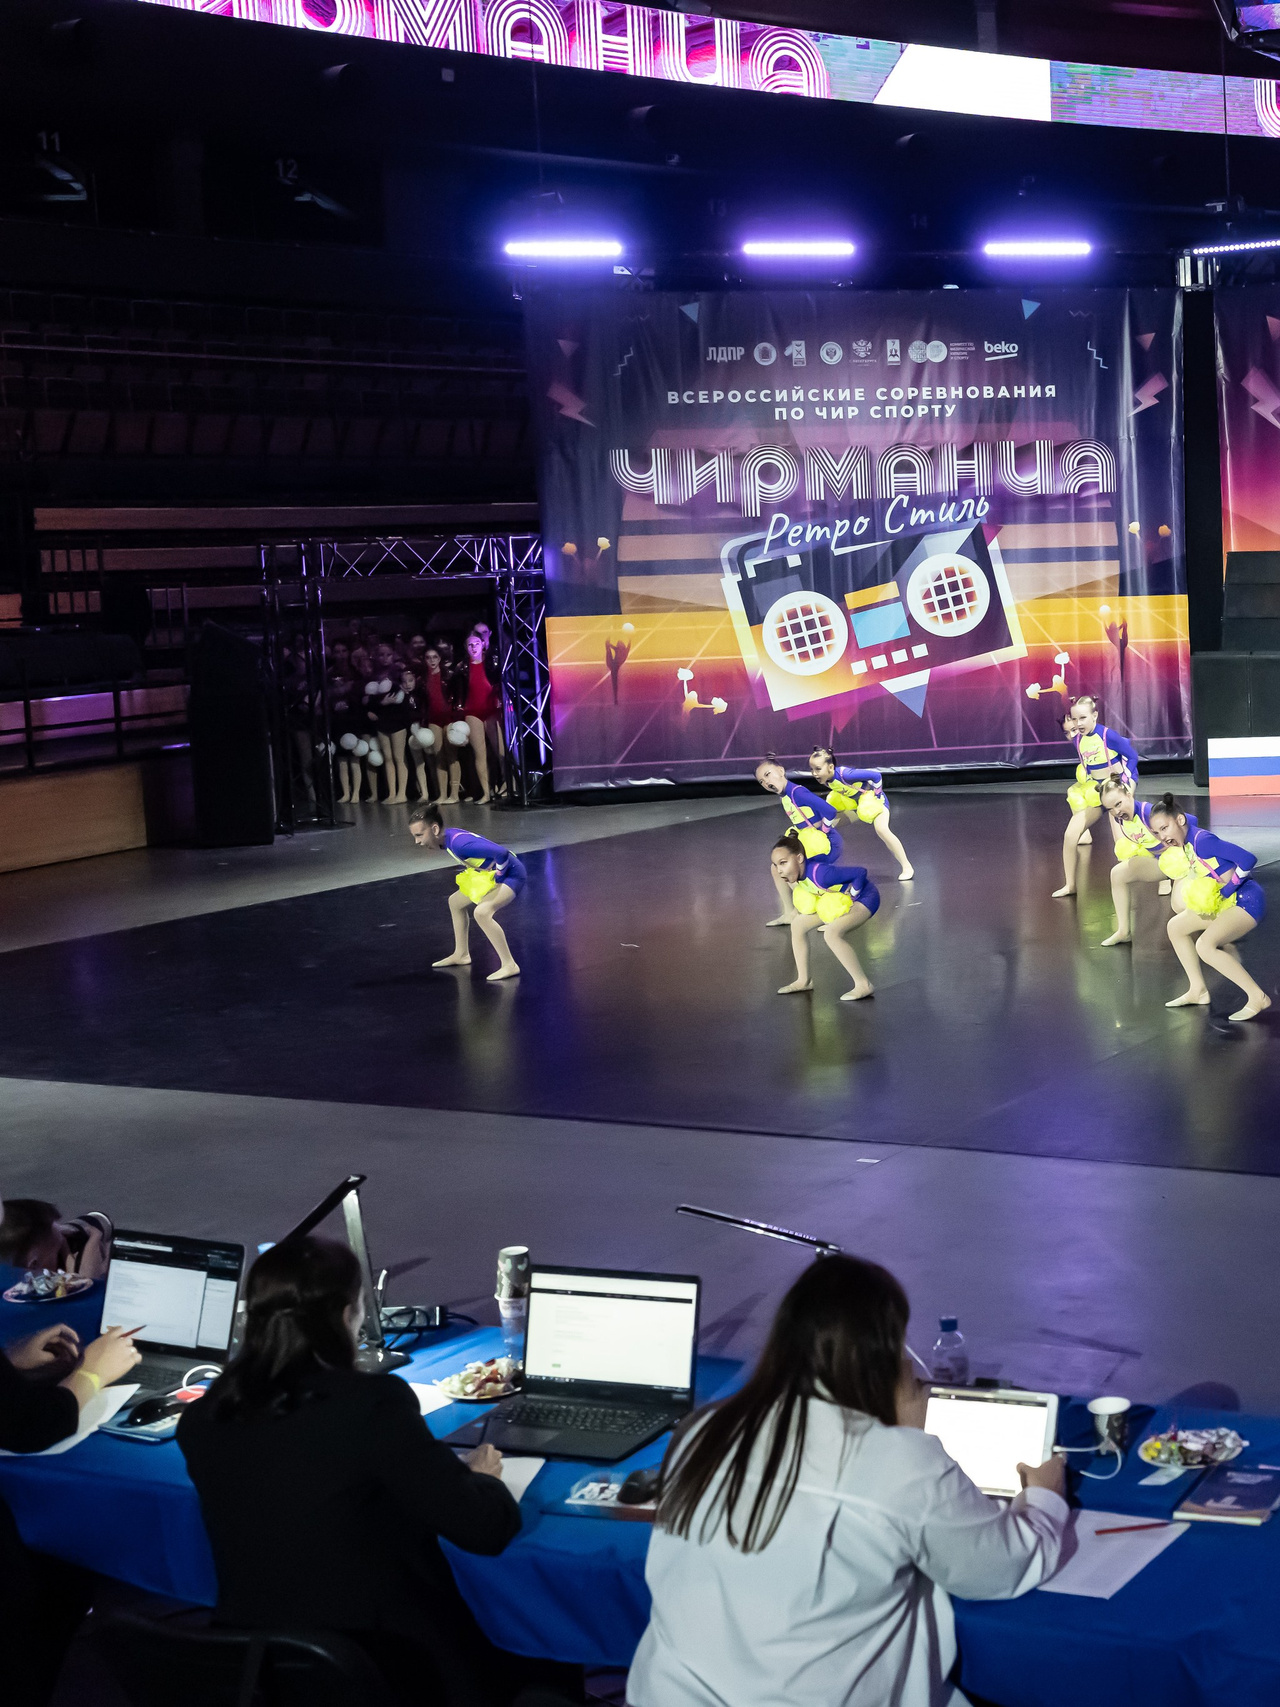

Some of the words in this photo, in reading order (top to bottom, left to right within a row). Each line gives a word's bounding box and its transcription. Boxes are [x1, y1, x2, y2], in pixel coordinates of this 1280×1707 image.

[706, 346, 745, 363] ЛДПР
[984, 341, 1019, 353] beko
[667, 386, 866, 404] ВСЕРОССИЙСКИЕ
[875, 384, 1057, 402] СОРЕВНОВАНИЯ
[774, 406, 805, 421] ПО
[815, 406, 860, 420] ЧИР
[869, 404, 957, 420] СПОРТУ
[763, 513, 871, 556] Ретро
[884, 493, 990, 534] Стиль
